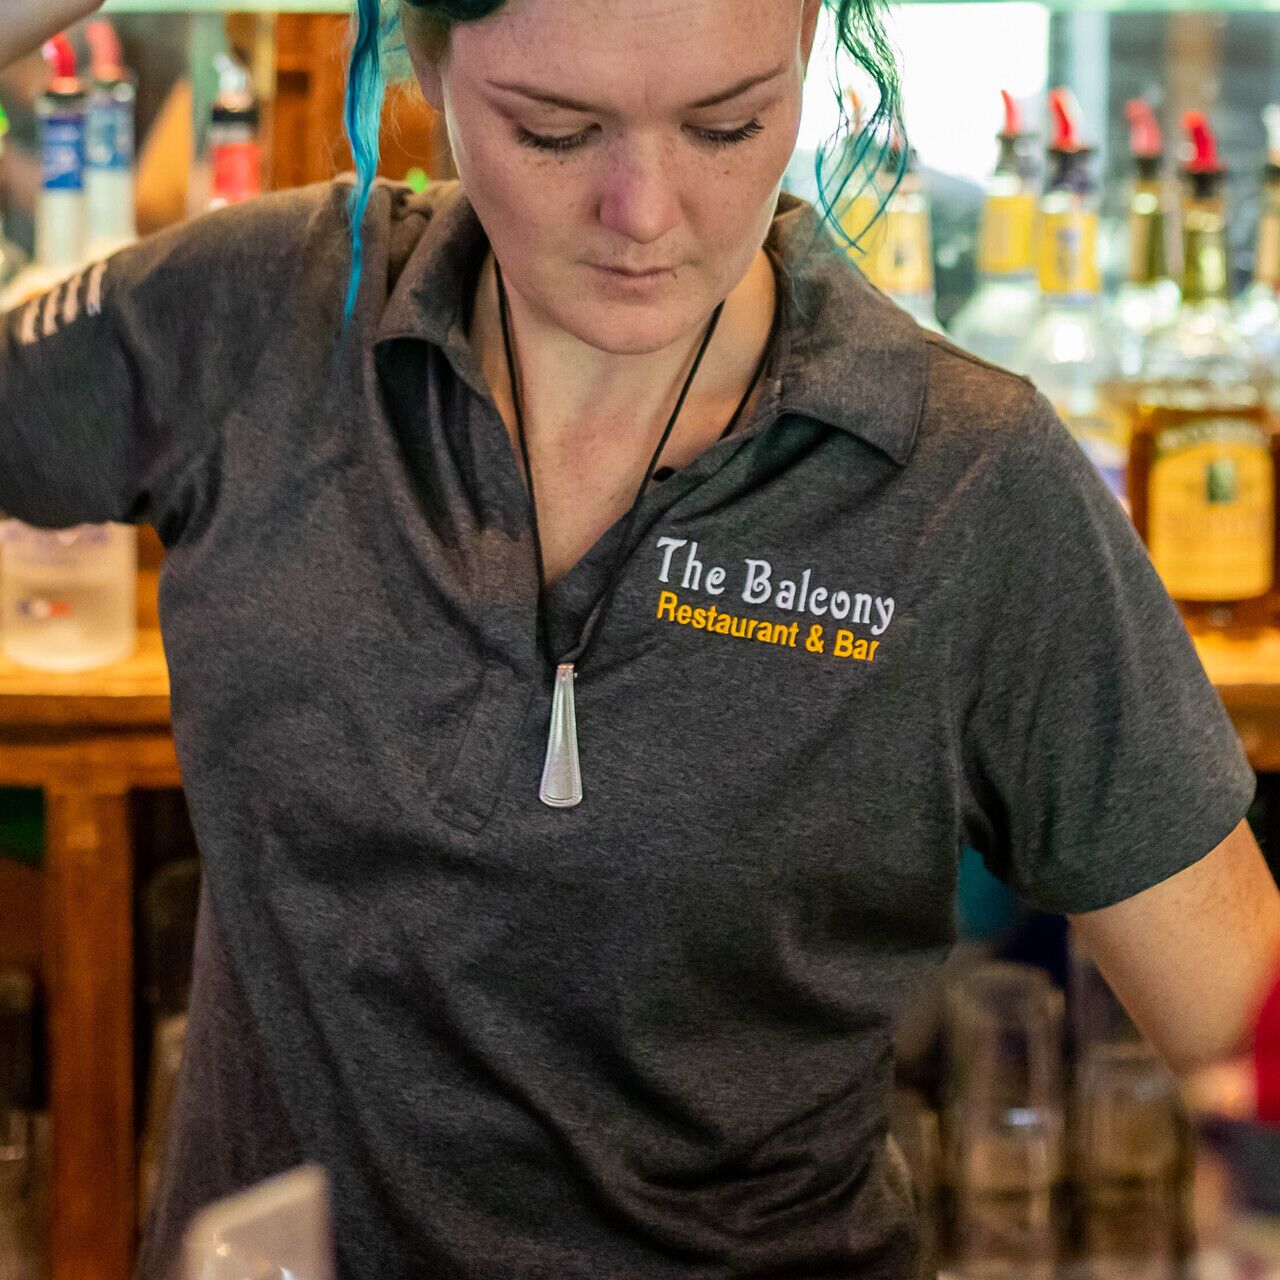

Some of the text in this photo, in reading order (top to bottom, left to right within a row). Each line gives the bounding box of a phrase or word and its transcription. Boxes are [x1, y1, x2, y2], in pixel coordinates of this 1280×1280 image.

[656, 536, 895, 636] The Balcony
[656, 590, 880, 662] Restaurant & Bar
